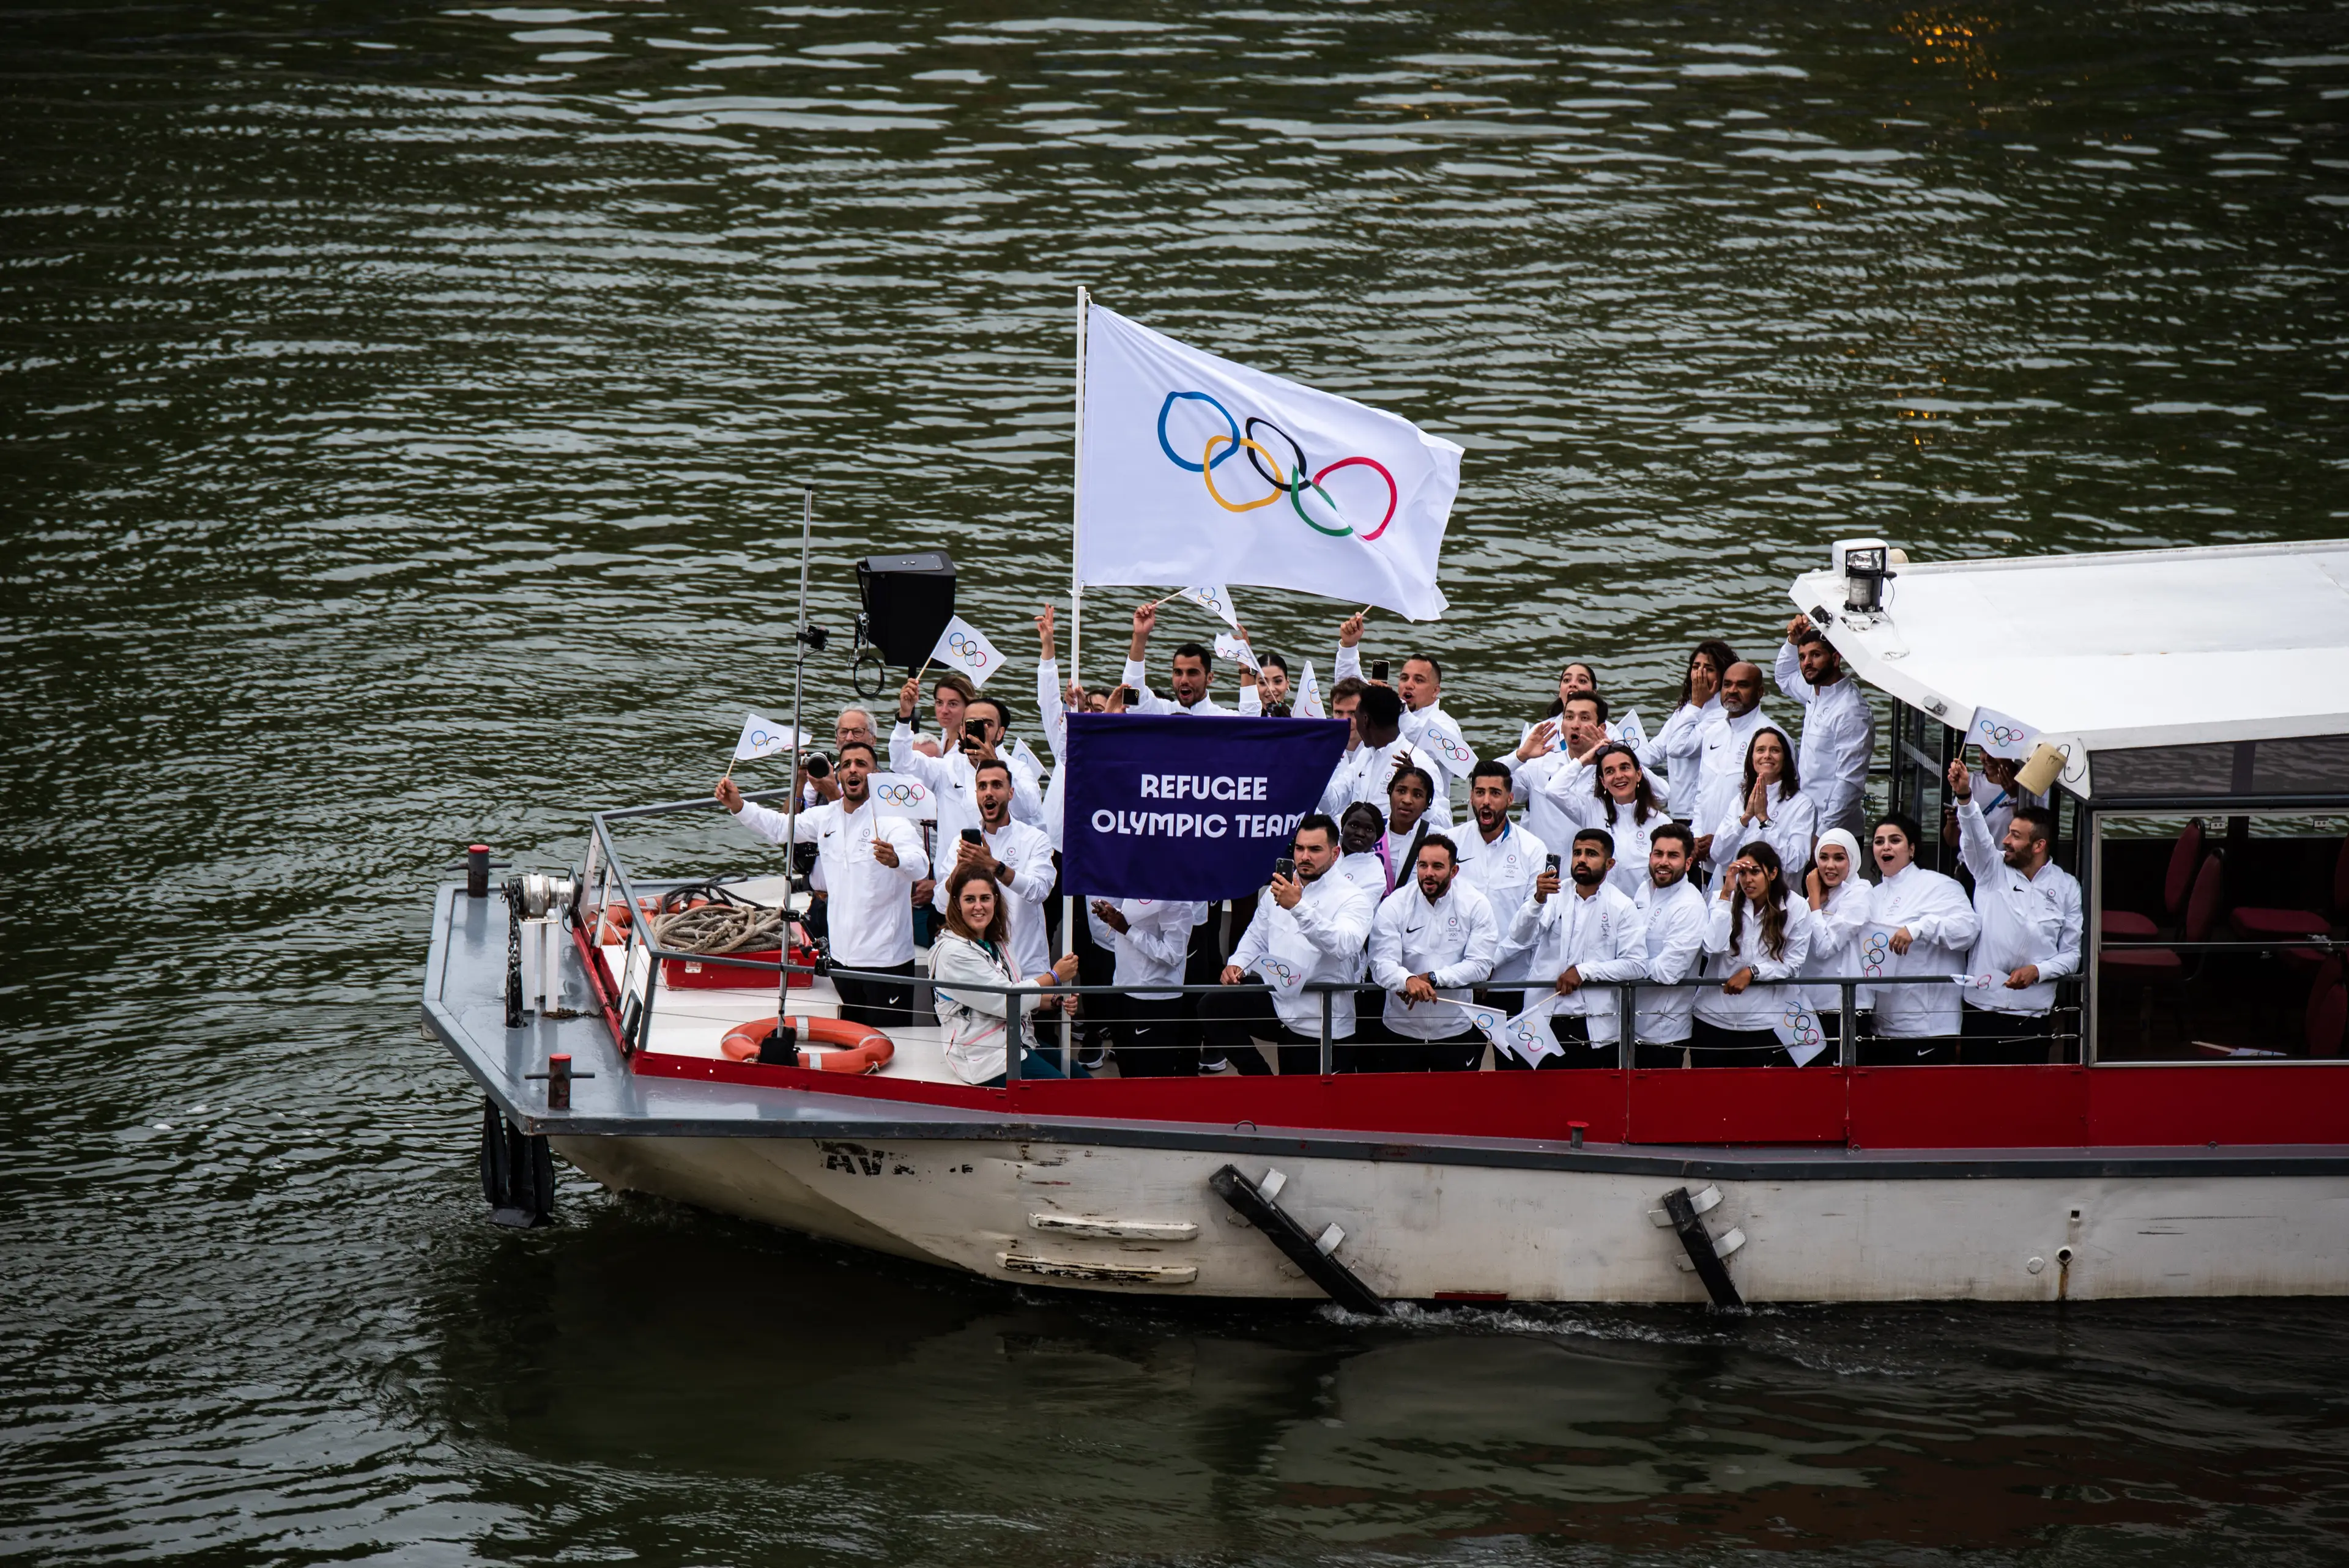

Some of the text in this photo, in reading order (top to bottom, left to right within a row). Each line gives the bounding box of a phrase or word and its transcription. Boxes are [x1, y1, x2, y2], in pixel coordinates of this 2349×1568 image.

[1141, 774, 1267, 801] REFUGEE
[1091, 809, 1306, 838] OLYMPIC TEAM
